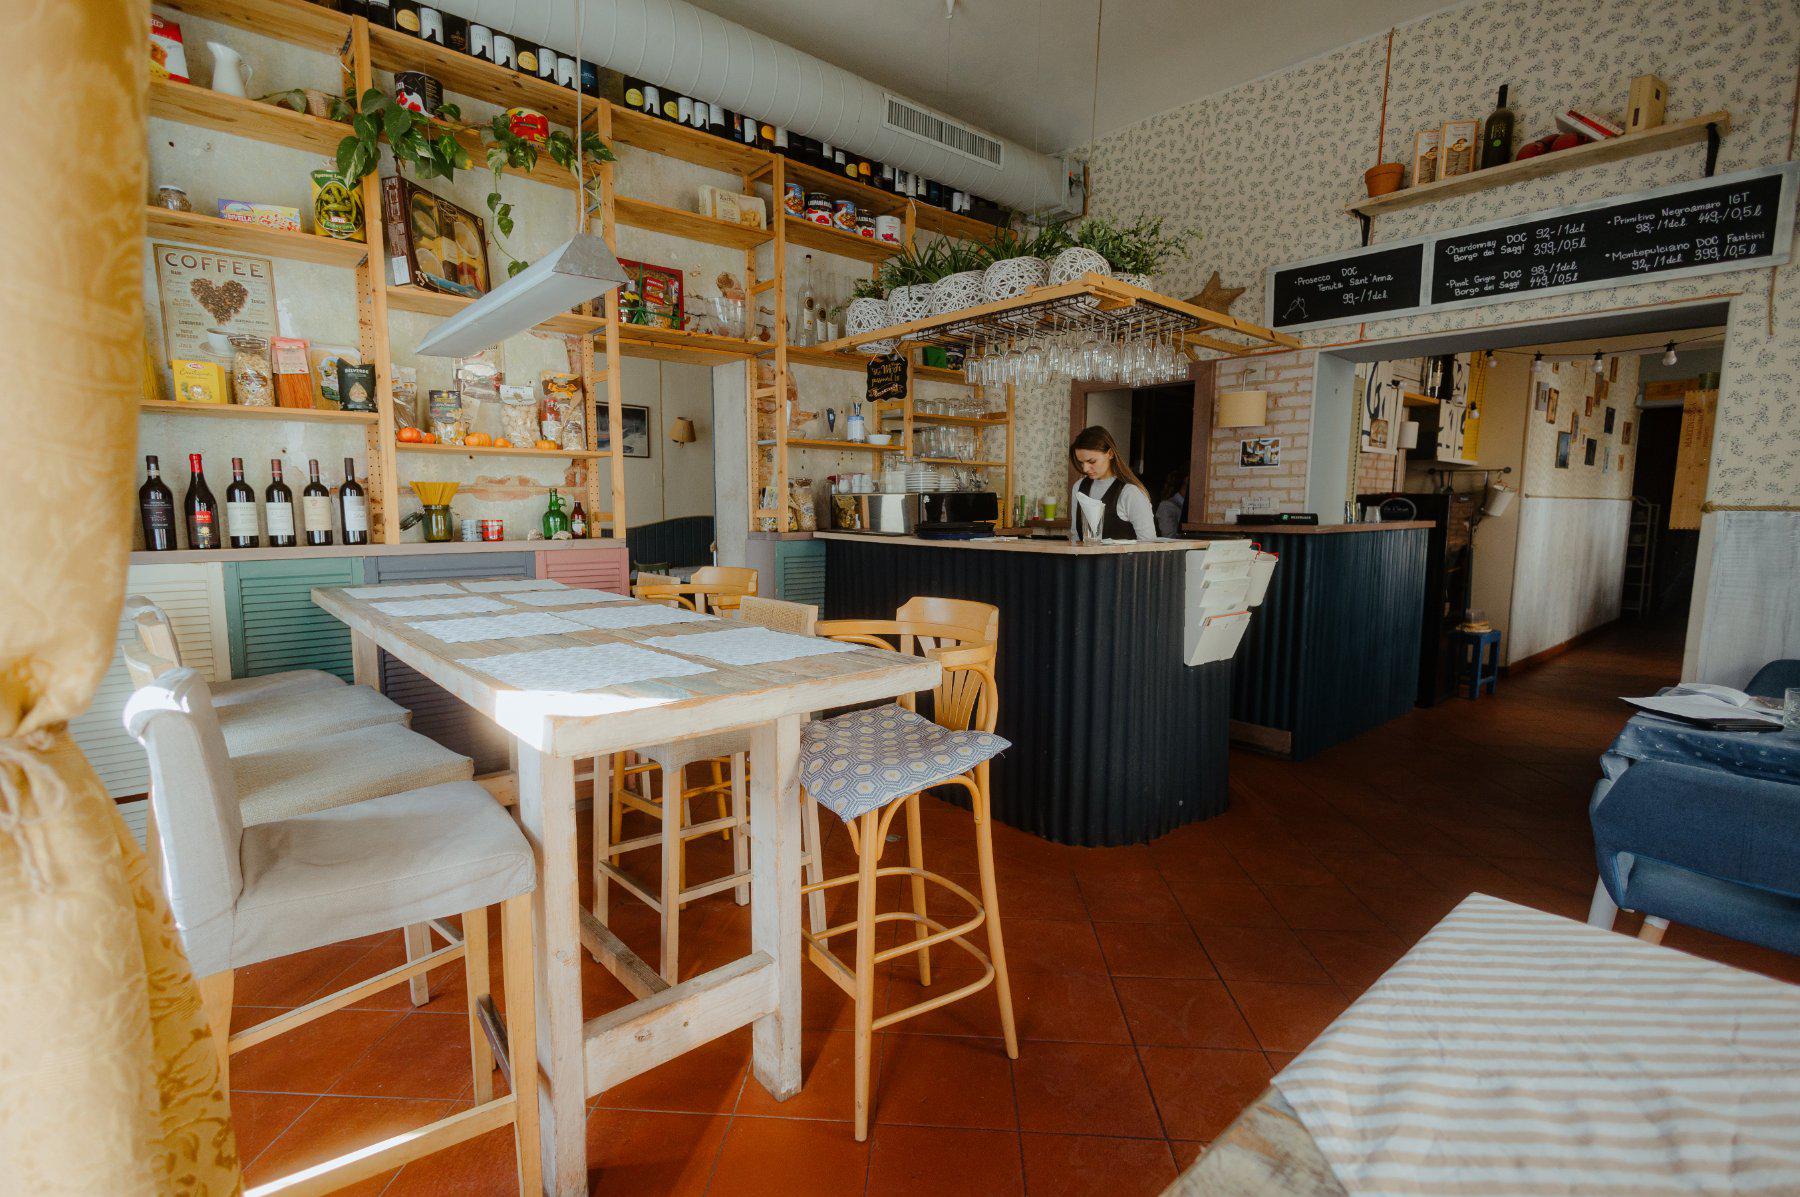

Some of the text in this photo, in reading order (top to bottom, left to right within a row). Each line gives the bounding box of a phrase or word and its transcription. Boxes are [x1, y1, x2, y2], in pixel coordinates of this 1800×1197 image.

[1613, 192, 1750, 226] Primitivo Negroamaro IGT
[1447, 239, 1497, 255] Chardonnay
[1506, 233, 1528, 245] DOC
[1453, 252, 1478, 263] Borgo
[1483, 249, 1495, 257] dei
[1500, 244, 1525, 255] Saggi
[1611, 232, 1765, 262] Montepulciano DOC Fantini
[165, 253, 264, 278] COFFEE
[1297, 266, 1358, 286] Prosecco DOC
[1449, 279, 1469, 289] Pinot
[1474, 275, 1496, 284] Grigio
[1503, 270, 1523, 280] DOC
[1318, 282, 1344, 292] Tenuta
[1454, 286, 1480, 297] Borgo
[1499, 281, 1520, 290] Saggi
